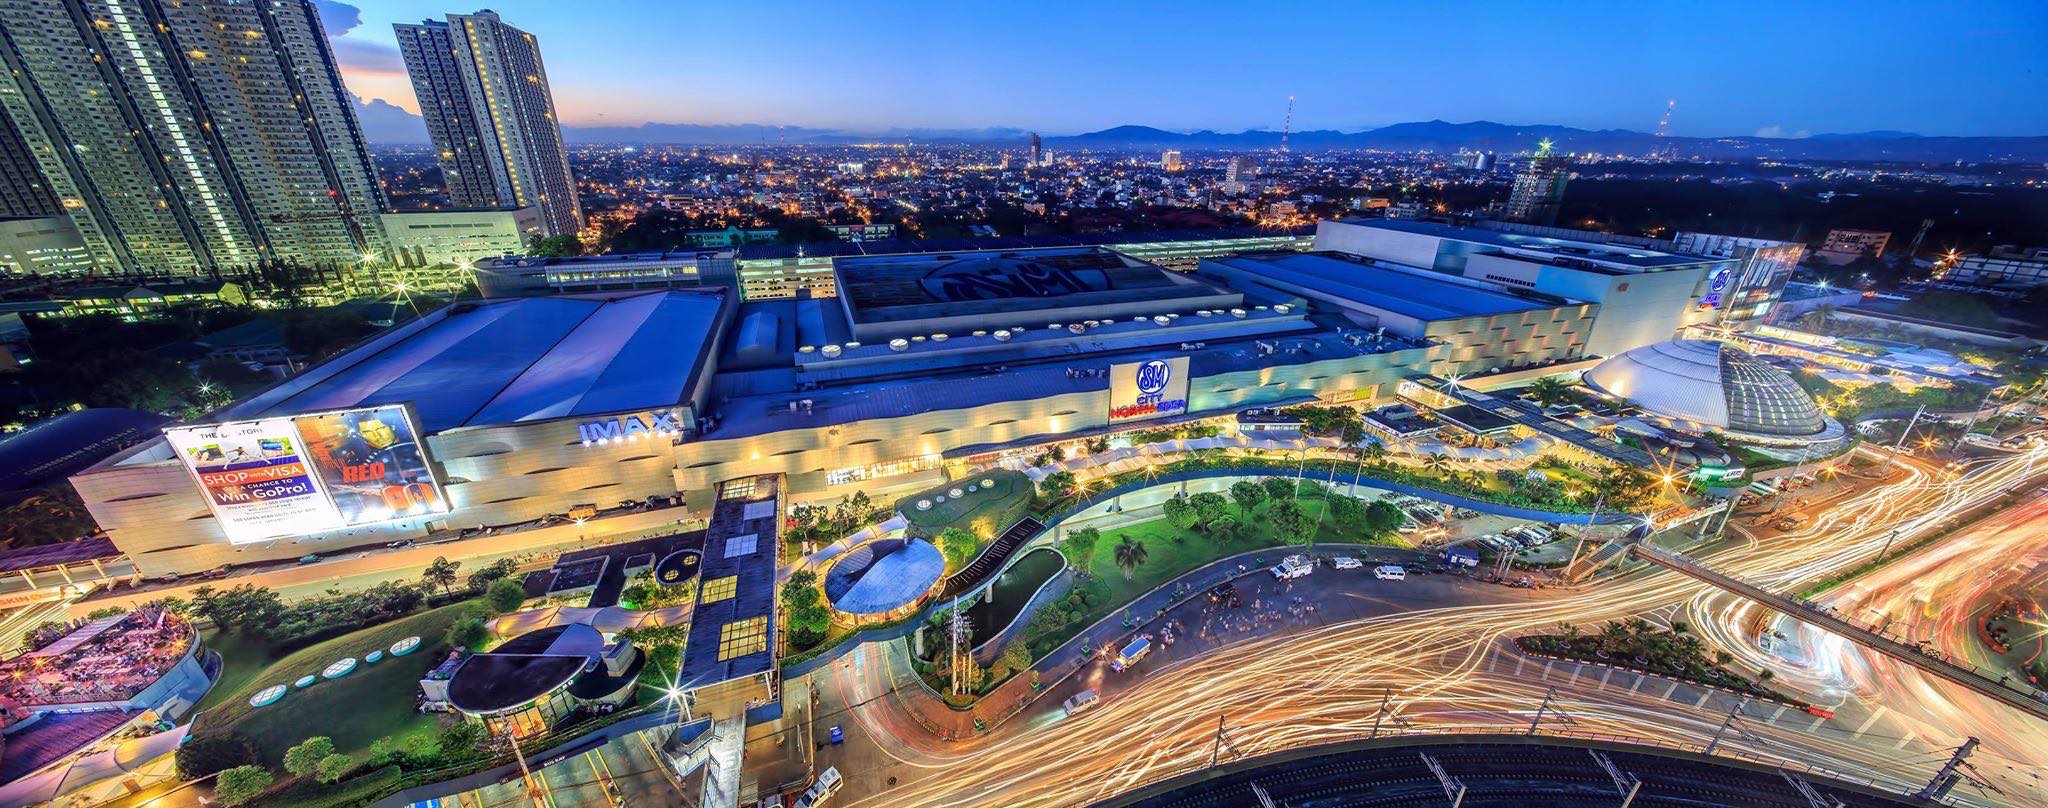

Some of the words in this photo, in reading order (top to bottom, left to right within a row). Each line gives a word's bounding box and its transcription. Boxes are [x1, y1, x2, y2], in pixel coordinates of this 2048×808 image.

[1139, 362, 1167, 391] SM
[1137, 394, 1163, 404] CITY
[1157, 400, 1185, 412] EDSA
[579, 412, 678, 441] IMAX
[204, 472, 248, 485] SHOP
[265, 465, 302, 478] VISA
[343, 462, 385, 482] RED
[218, 492, 250, 502] Win
[253, 482, 308, 498] GoPro!
[248, 481, 280, 489] CHANCE
